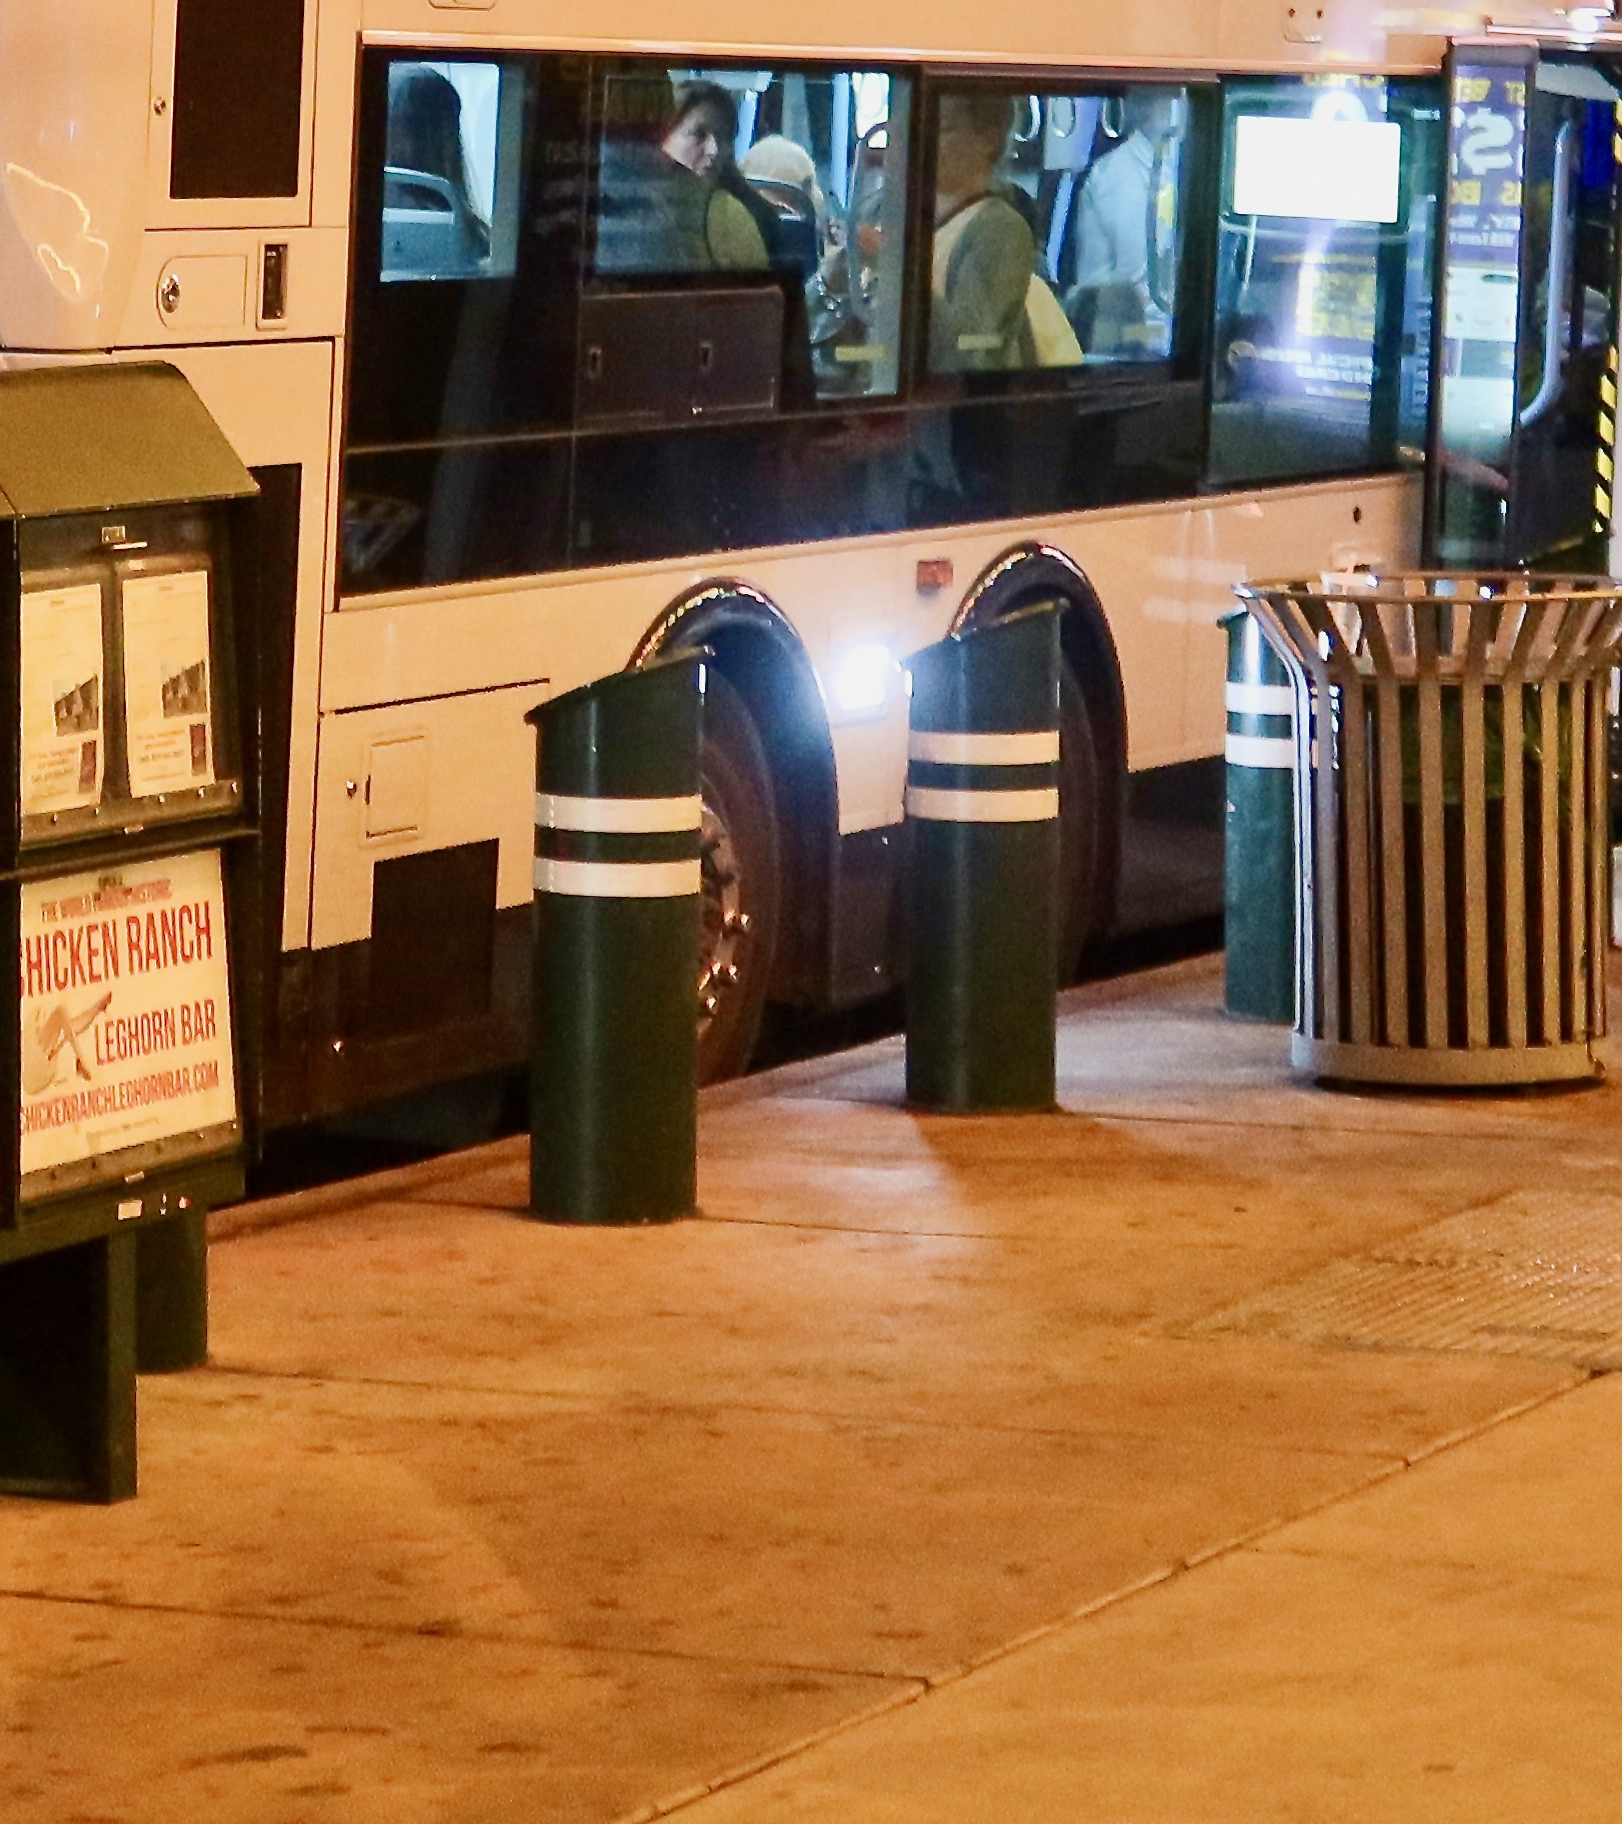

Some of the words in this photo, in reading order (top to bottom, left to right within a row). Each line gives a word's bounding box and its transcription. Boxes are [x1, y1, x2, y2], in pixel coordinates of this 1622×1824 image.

[22, 919, 120, 998] HICKEN
[126, 901, 213, 976] RANCH
[93, 1007, 176, 1066] LEGHORN
[180, 999, 217, 1046] BAR
